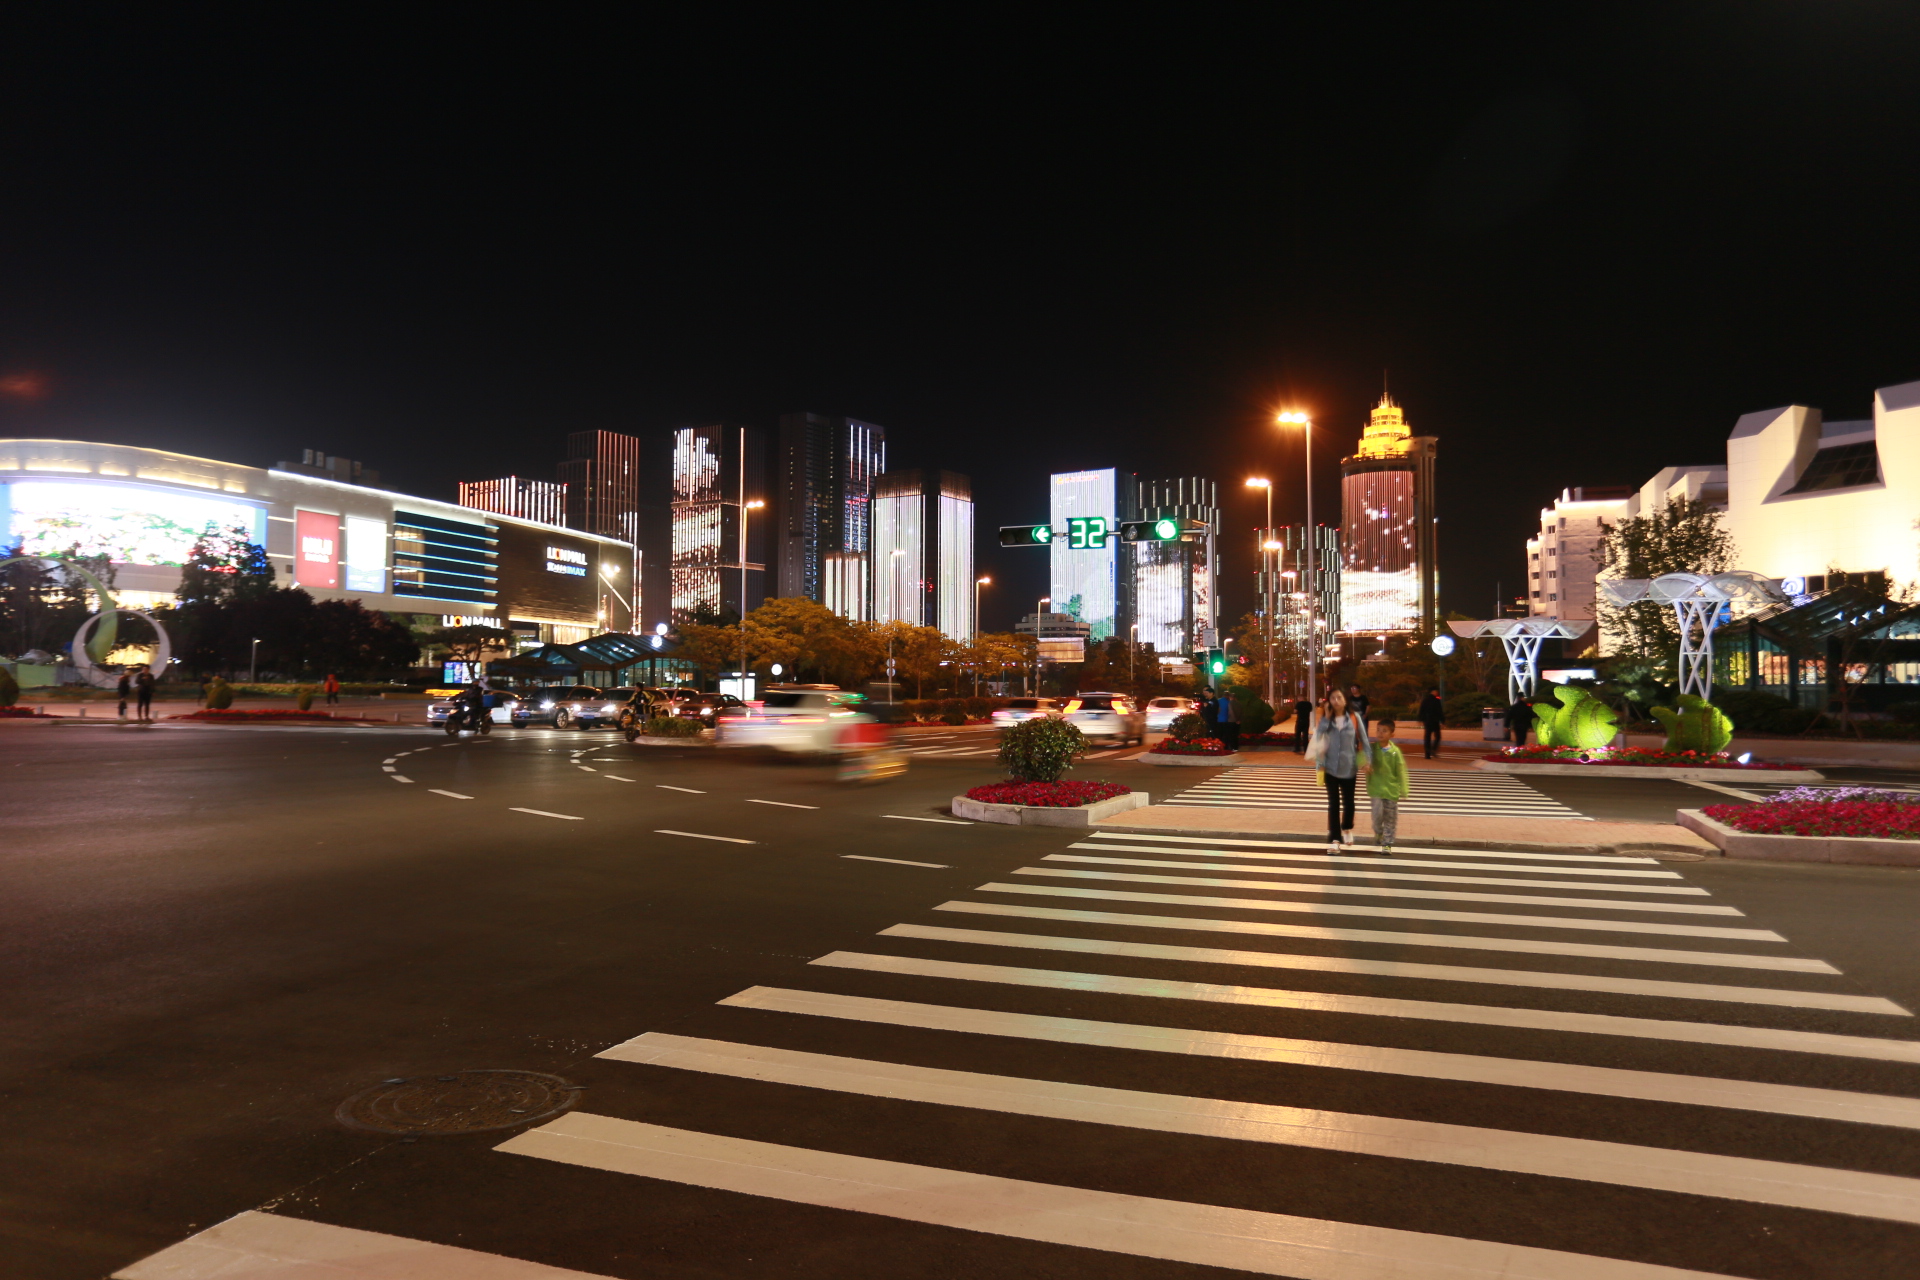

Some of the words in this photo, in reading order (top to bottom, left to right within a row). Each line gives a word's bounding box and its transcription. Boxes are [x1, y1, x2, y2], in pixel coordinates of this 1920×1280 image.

[1071, 519, 1105, 548] 32
[546, 546, 567, 562] LION
[443, 614, 472, 628] LION
[472, 616, 504, 630] MALL
